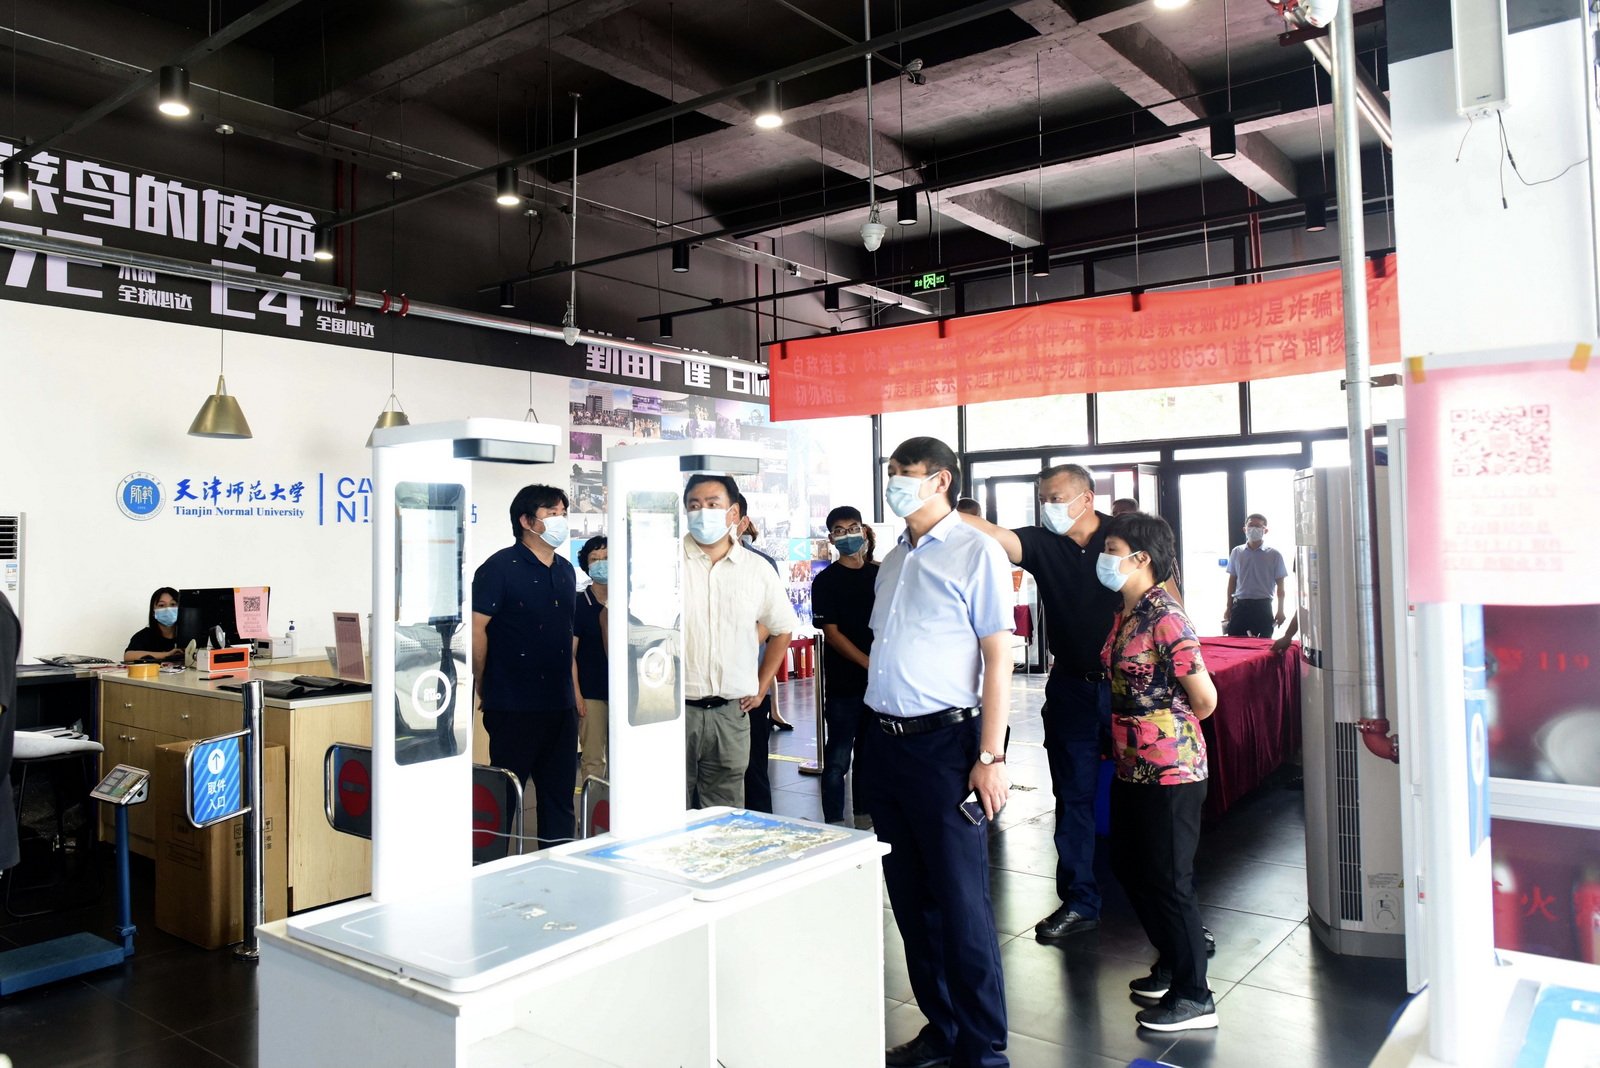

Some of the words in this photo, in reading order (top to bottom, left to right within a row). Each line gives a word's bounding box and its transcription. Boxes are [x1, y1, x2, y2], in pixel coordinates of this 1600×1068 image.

[118, 284, 192, 311] 全球必达
[316, 315, 375, 339] 全国必达
[174, 475, 305, 506] 天津师范大学
[173, 505, 213, 518] Tianjin
[215, 506, 254, 517] Normal
[256, 506, 305, 519] University
[207, 779, 227, 796] 取件
[207, 796, 226, 813] 入口
